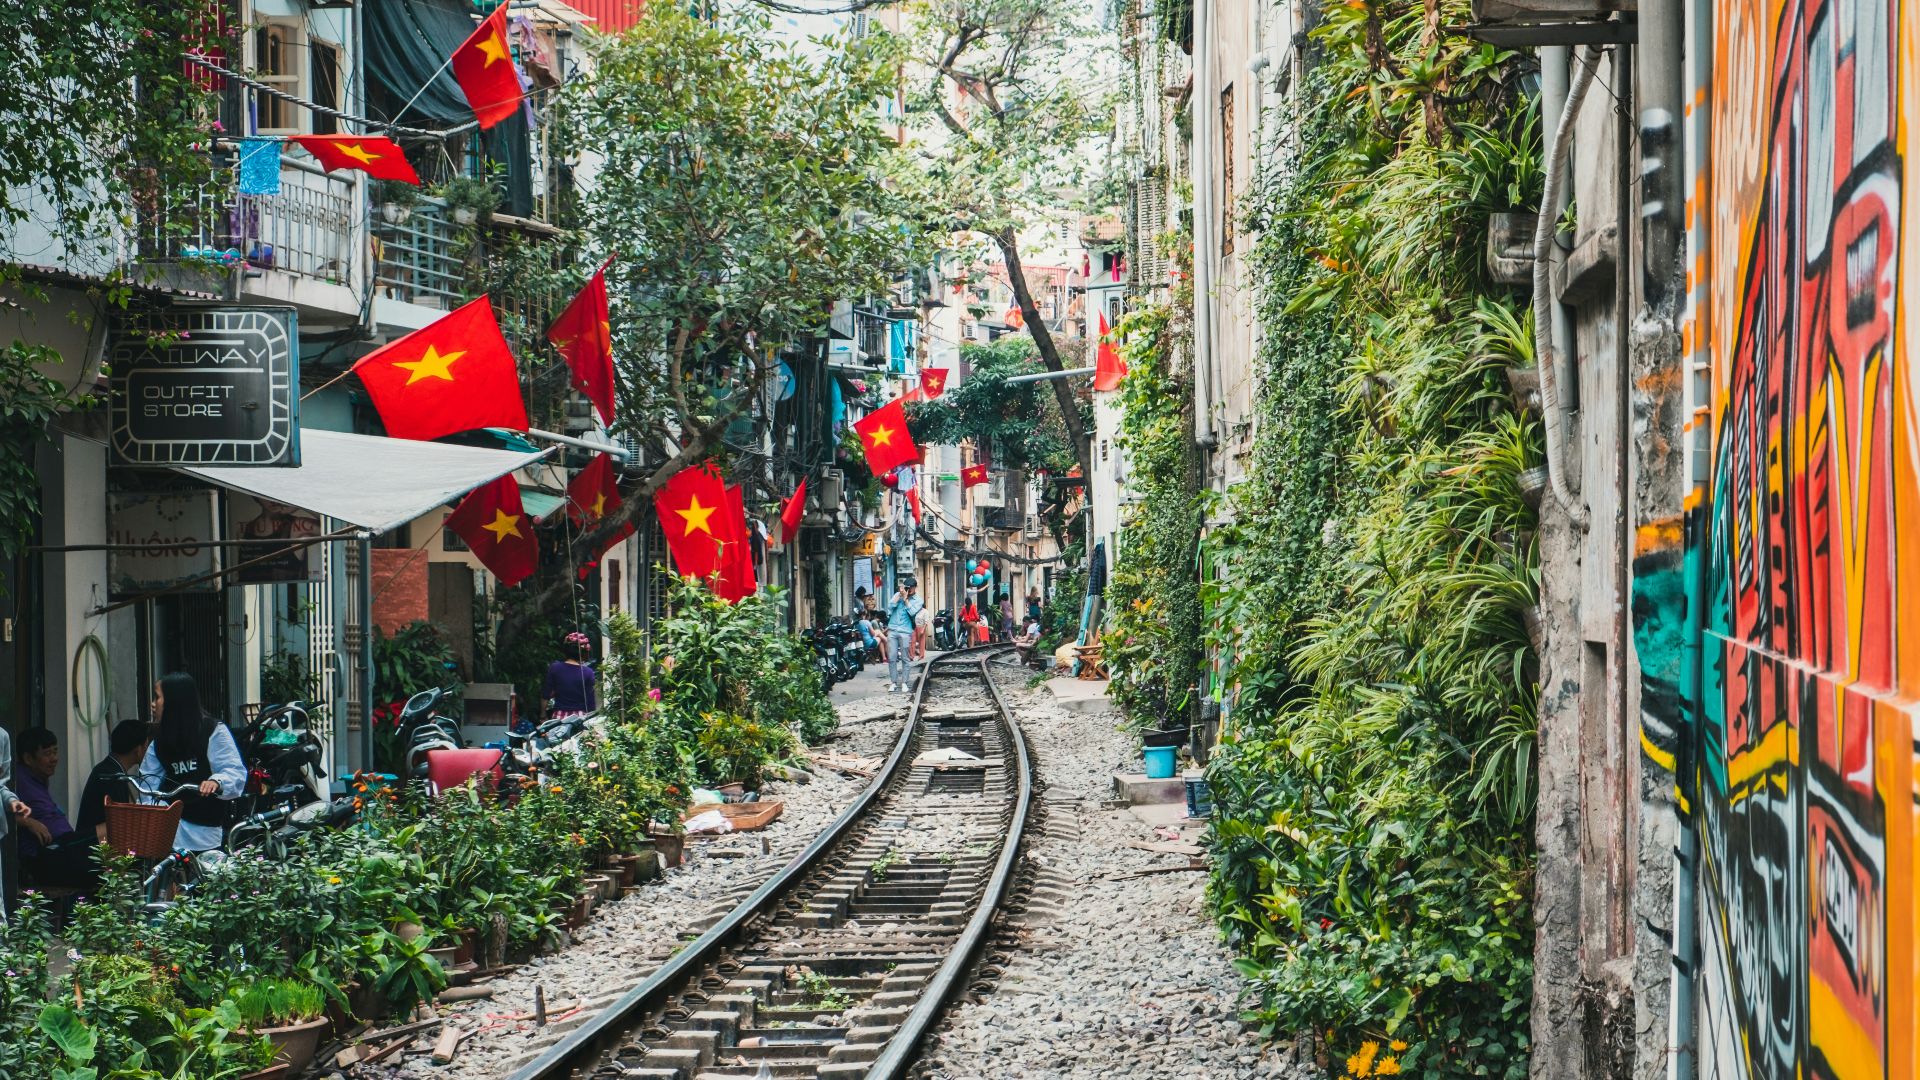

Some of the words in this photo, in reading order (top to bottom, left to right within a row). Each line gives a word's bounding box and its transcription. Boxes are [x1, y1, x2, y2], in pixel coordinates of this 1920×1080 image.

[114, 348, 267, 365] RAILWAY
[143, 385, 235, 400] OUTFIT
[143, 403, 223, 417] STORE
